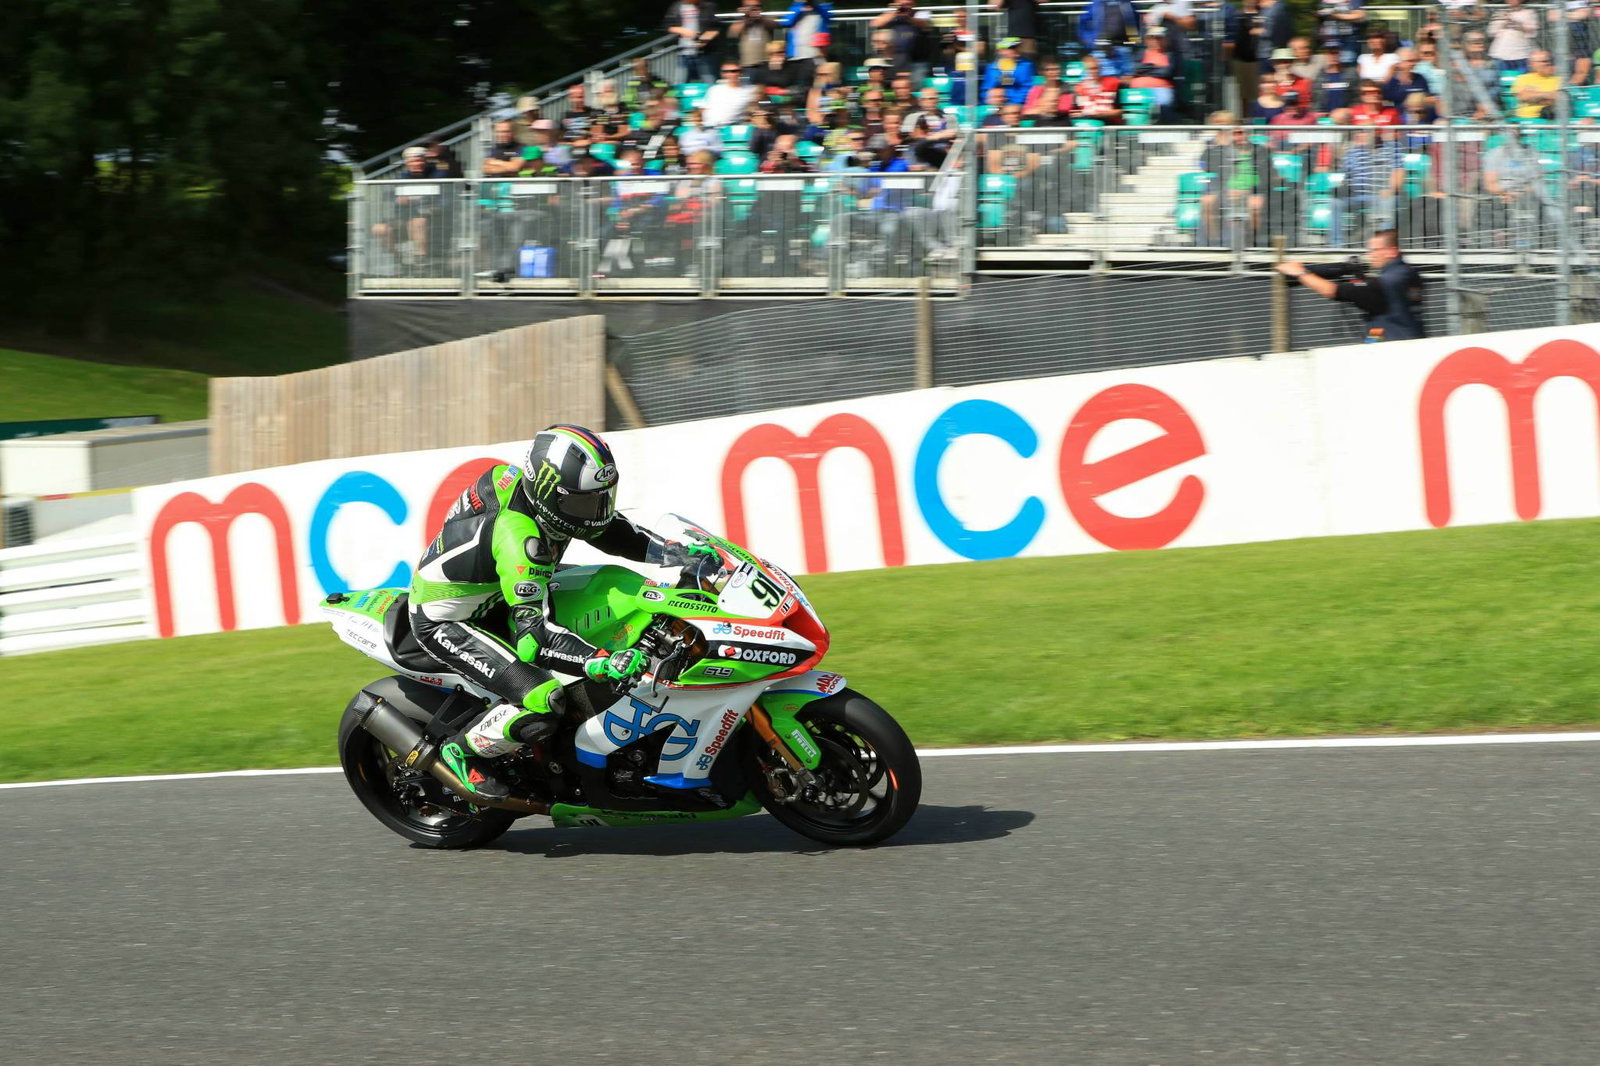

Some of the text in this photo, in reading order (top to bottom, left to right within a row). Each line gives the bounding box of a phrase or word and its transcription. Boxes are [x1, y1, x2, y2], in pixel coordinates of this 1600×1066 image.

[720, 383, 1208, 572] mce
[536, 500, 576, 531] MONSTER
[667, 599, 718, 613] ACCOSSATO
[747, 571, 787, 612] 91
[733, 625, 786, 641] Speedfit
[432, 628, 495, 679] Kawasaki
[540, 647, 588, 664] Kawasaki
[742, 649, 796, 665] OXFORD
[815, 673, 839, 693] MAC
[705, 708, 739, 756] Speedfit
[791, 728, 817, 758] PIRELLI
